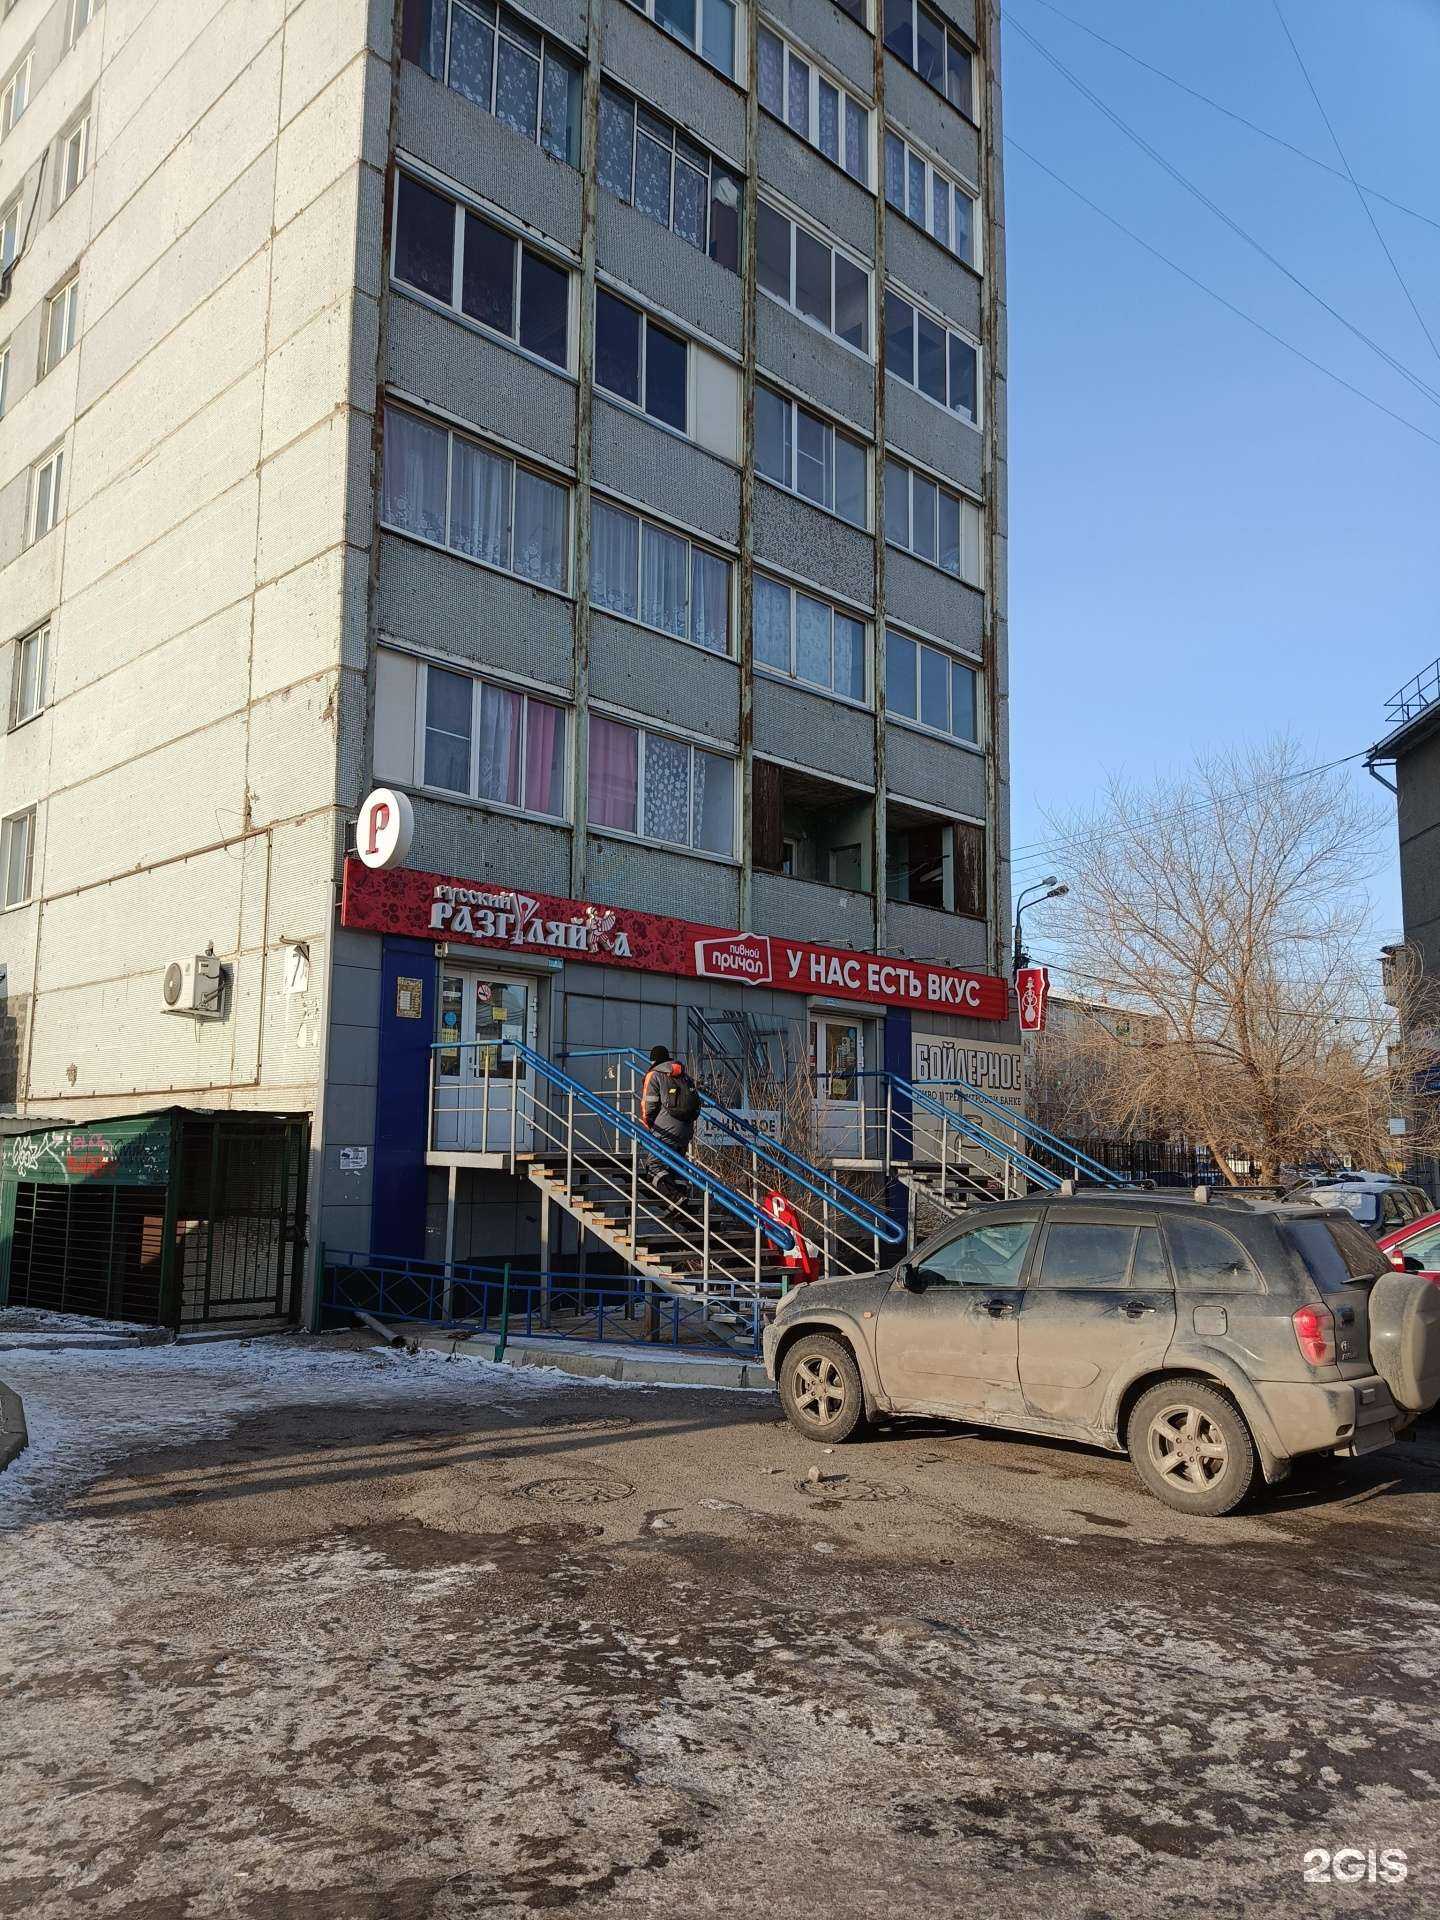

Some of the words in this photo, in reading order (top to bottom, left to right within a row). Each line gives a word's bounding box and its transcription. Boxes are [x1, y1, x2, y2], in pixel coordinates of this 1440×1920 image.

[786, 949, 803, 979] У
[810, 953, 861, 989] НАС
[867, 963, 922, 998] ЕСТЬ
[927, 973, 981, 1007] ВКУС
[915, 1041, 1022, 1090] БОЙЛЕРНОЕ
